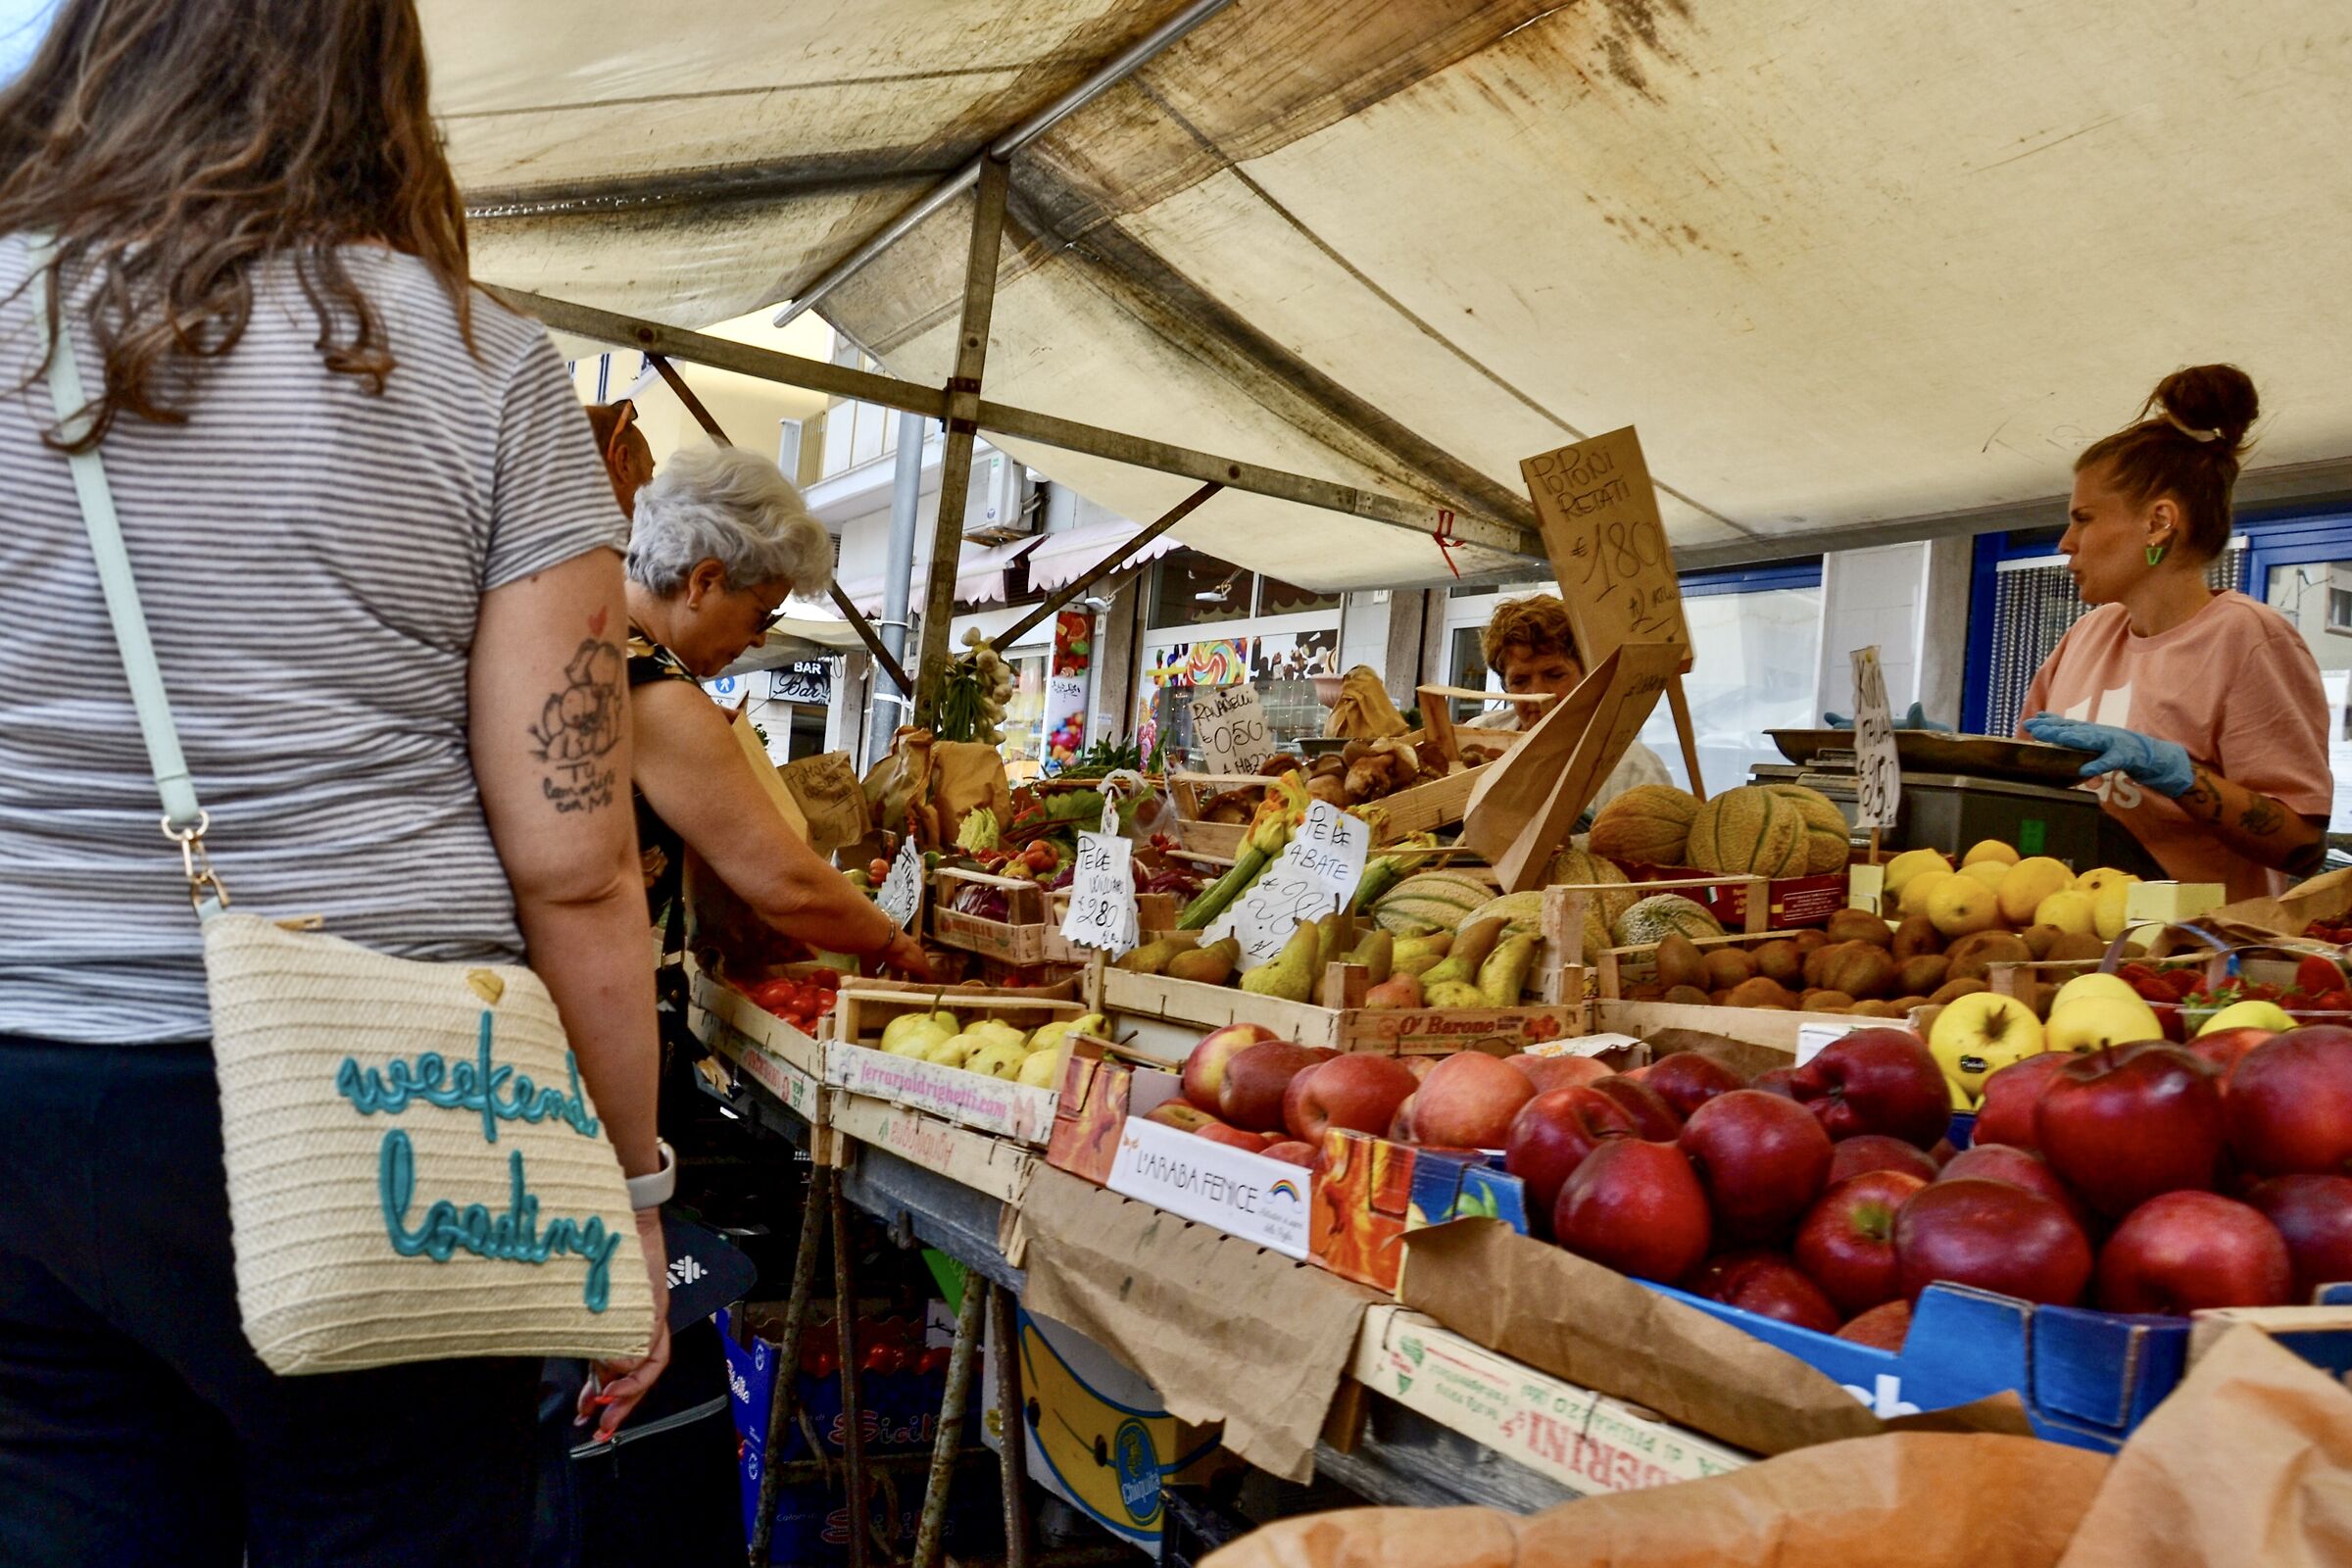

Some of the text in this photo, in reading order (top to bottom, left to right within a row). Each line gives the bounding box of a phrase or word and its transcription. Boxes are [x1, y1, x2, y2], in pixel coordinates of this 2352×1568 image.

[772, 673, 821, 699] Bar
[793, 661, 822, 675] BAR
[1290, 844, 1349, 881] ABATE
[1425, 1015, 1495, 1035] Barone
[335, 1009, 601, 1144] weekend
[1136, 1150, 1259, 1214] L'ARABA FENICE
[378, 1128, 621, 1313] loading
[1121, 1468, 1161, 1505] Chiquita
